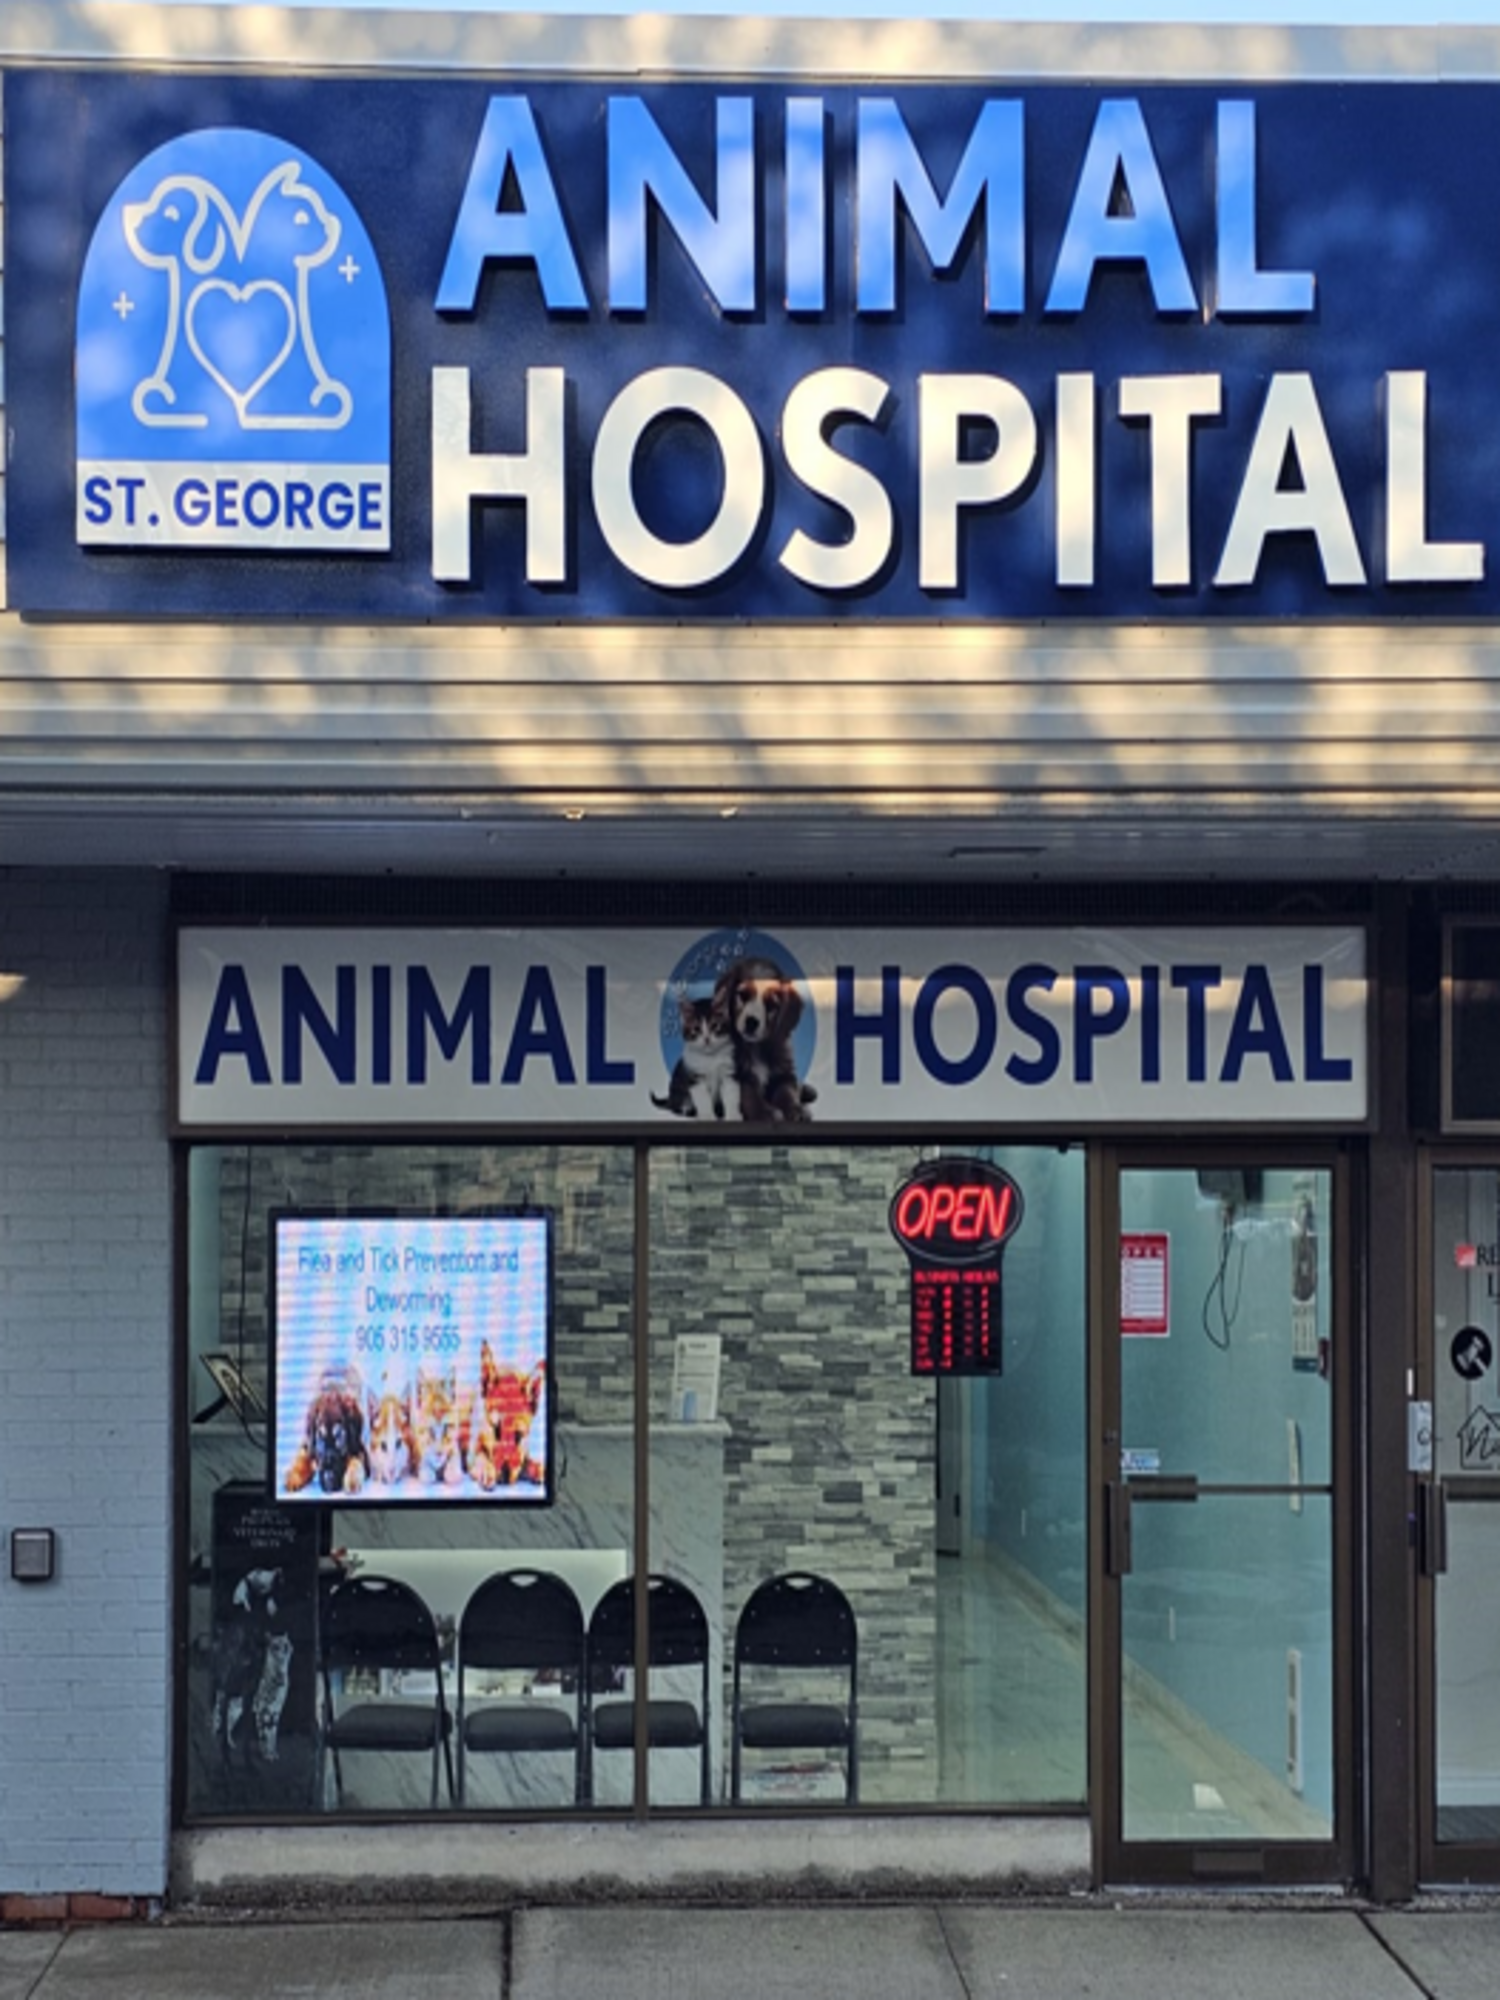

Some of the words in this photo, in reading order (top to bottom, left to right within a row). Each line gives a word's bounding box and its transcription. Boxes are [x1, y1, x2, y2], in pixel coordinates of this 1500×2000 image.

[434, 95, 1315, 316] ANIMAL
[85, 477, 159, 525] ST.
[174, 479, 382, 530] GEORGE
[431, 366, 1484, 588] HOSPITAL
[194, 965, 635, 1085] ANIMAL
[834, 964, 1352, 1085] HOSPITAL
[896, 1184, 1011, 1240] OPEN
[298, 1246, 331, 1273] Flea
[336, 1247, 365, 1273] and
[369, 1246, 399, 1273] Tick
[404, 1246, 485, 1273] Prevention
[490, 1247, 519, 1273] and
[366, 1285, 452, 1318] Deworming
[389, 1325, 419, 1352] 315
